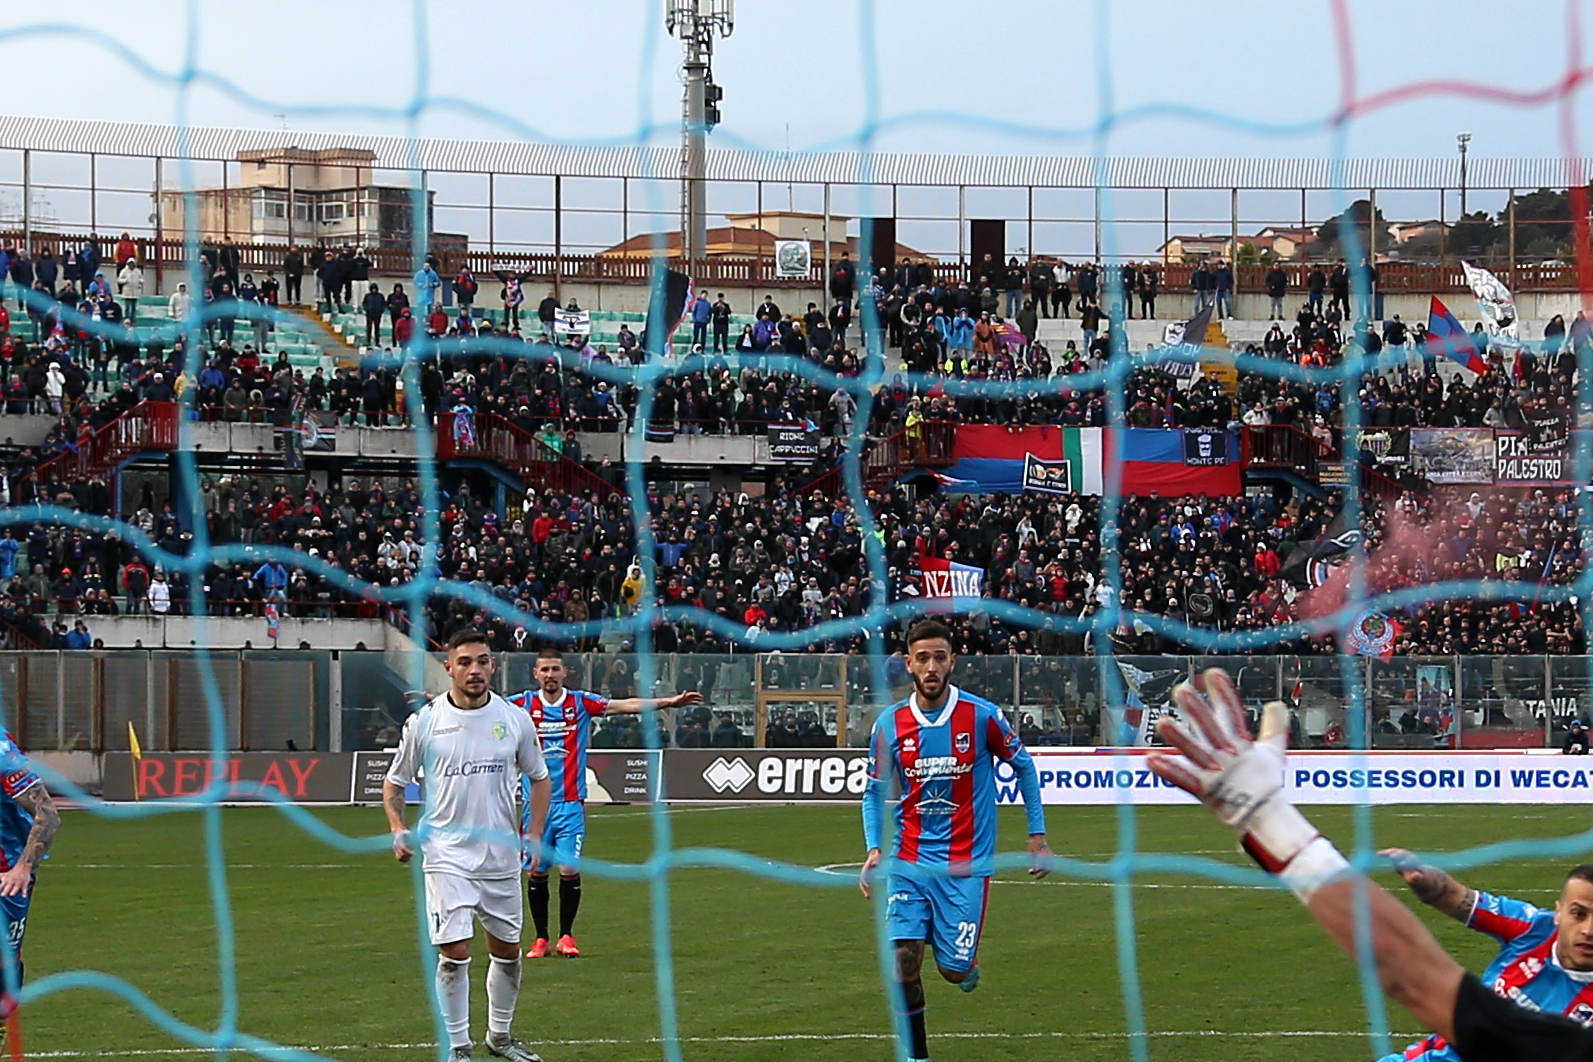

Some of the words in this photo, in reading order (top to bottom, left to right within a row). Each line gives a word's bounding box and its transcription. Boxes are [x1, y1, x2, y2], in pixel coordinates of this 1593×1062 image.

[1498, 436, 1562, 456] PIA
[1498, 459, 1561, 479] PALESTRO
[1521, 698, 1577, 718] TANIA
[138, 758, 320, 797] REPLAY
[625, 773, 648, 781] PIZZA
[1040, 770, 1178, 788] PROMOZI
[1295, 769, 1464, 788] POSSESSORI
[1475, 769, 1501, 788] DI
[364, 787, 383, 795] DRIN
[956, 921, 977, 948] 23
